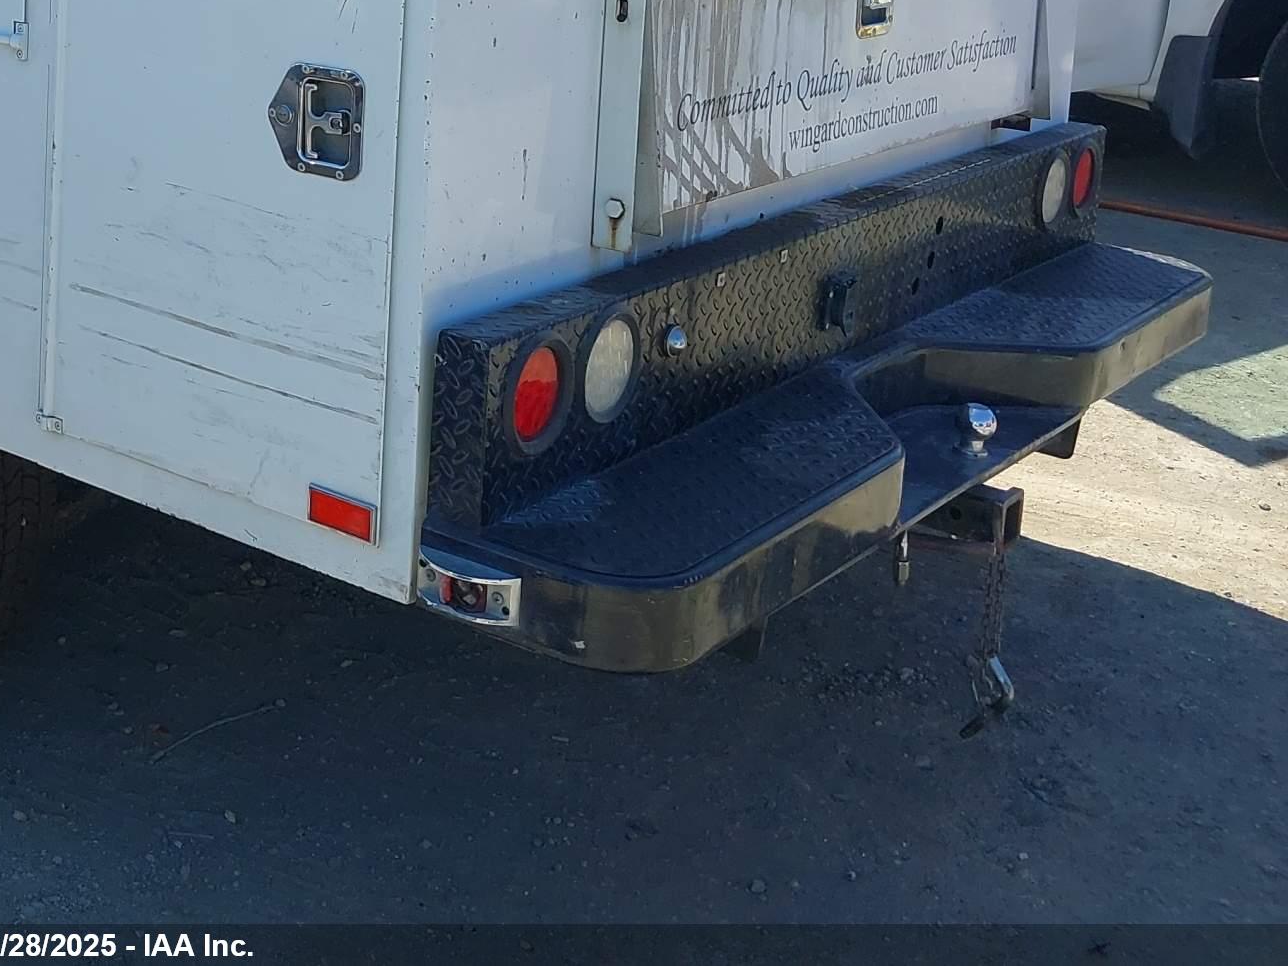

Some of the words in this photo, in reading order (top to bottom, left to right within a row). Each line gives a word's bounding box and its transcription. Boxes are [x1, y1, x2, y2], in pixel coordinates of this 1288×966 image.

[677, 70, 776, 132] Committed
[776, 78, 792, 106] to
[797, 59, 853, 112] Quality
[856, 49, 887, 88] and
[886, 50, 947, 85] Customer
[947, 29, 1017, 72] Satisfaction
[789, 94, 939, 153] wingardconstruction.com
